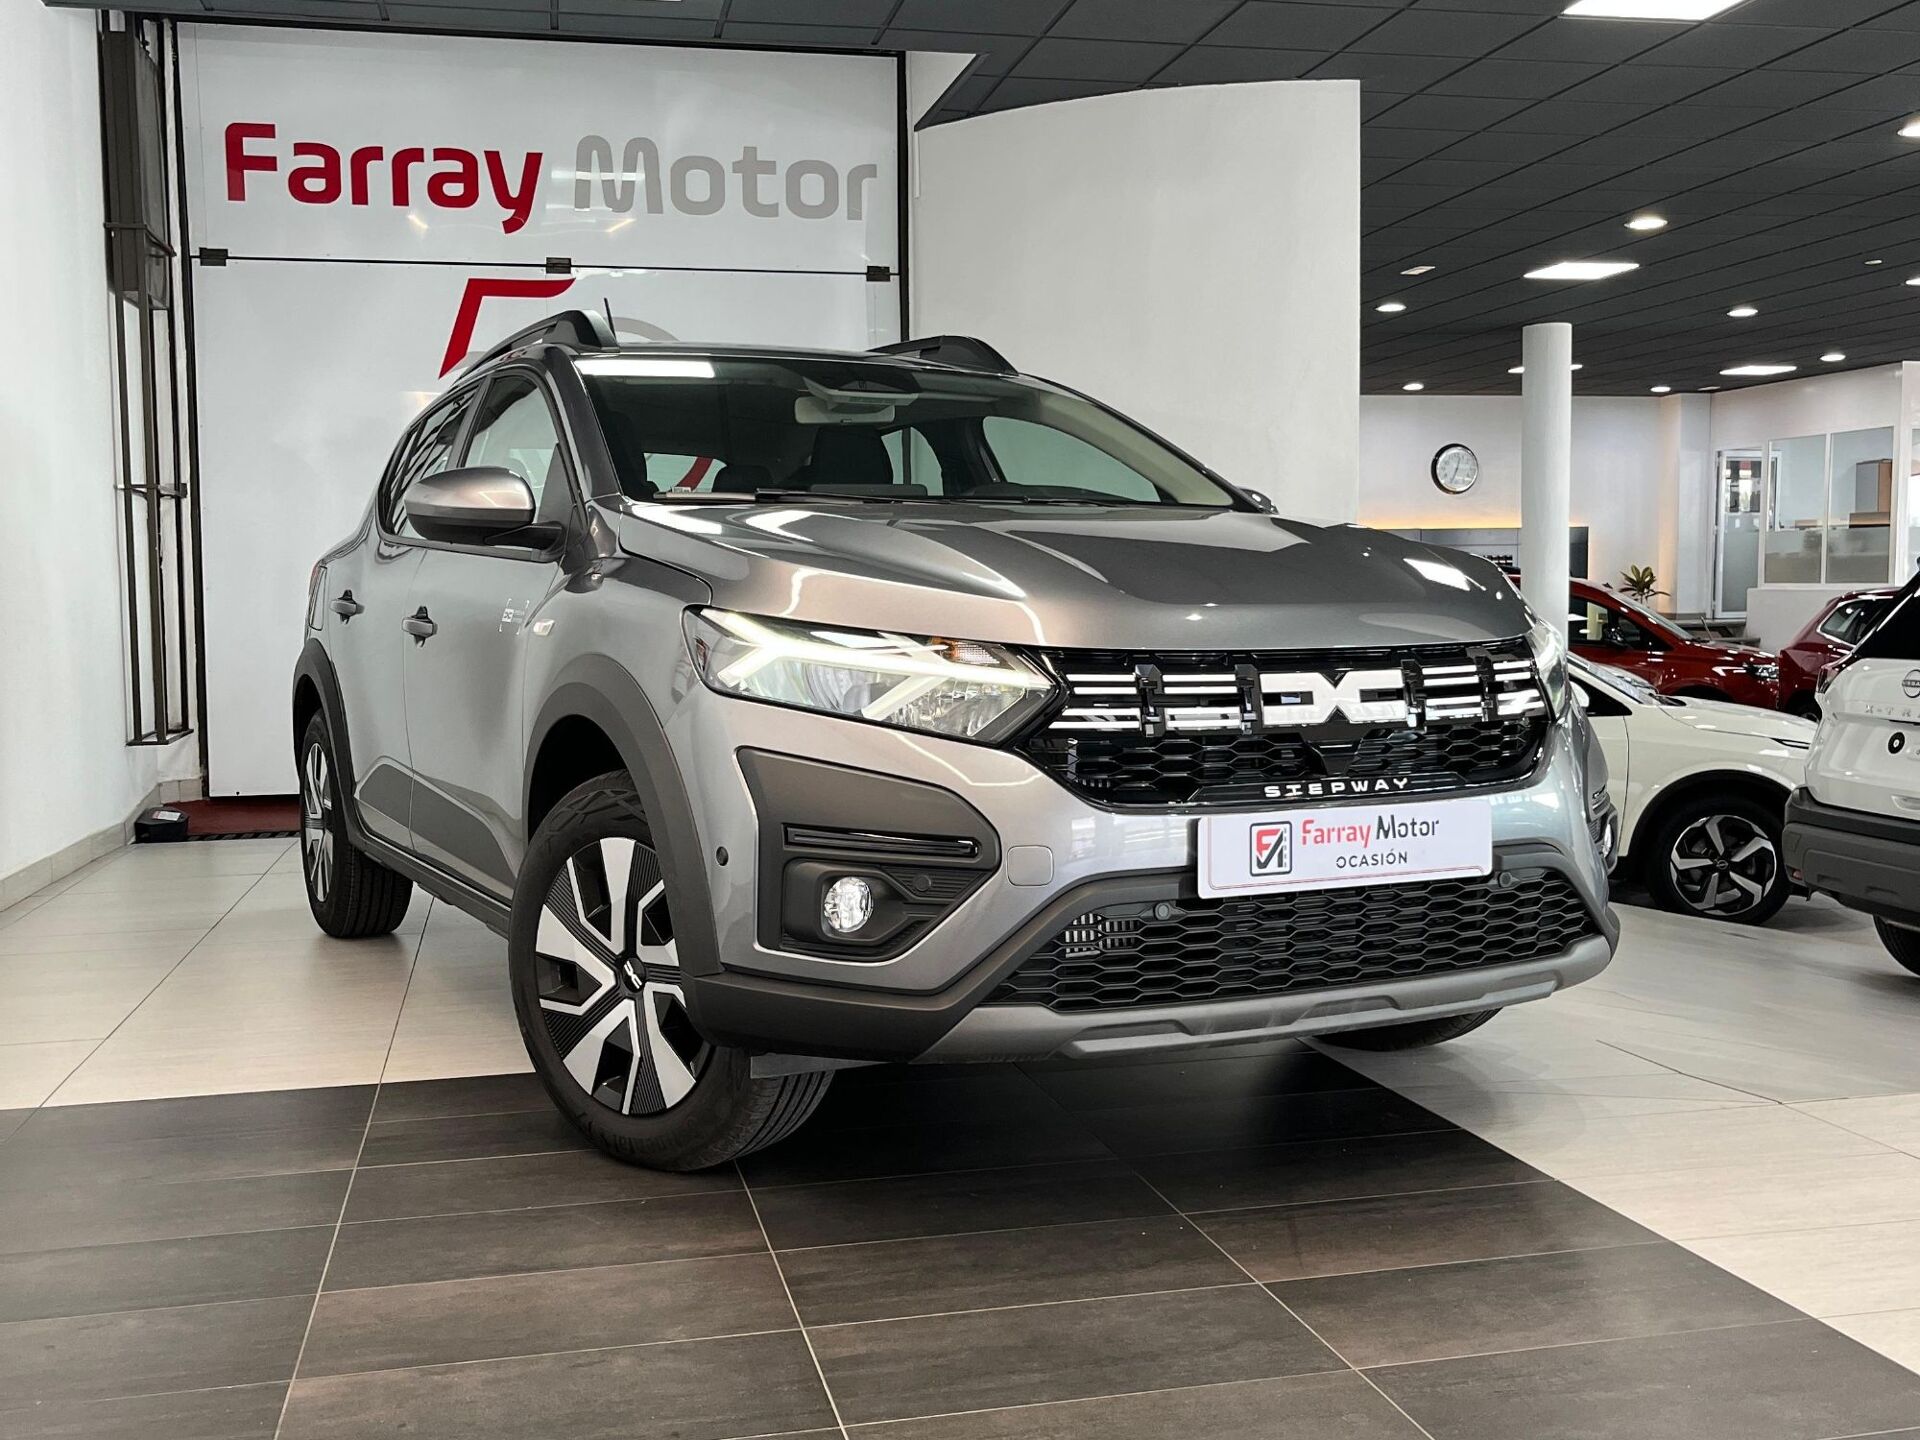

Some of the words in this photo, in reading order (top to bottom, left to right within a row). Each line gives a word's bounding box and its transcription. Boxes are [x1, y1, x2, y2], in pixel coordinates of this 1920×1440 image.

[225, 122, 542, 234] Farray
[574, 135, 877, 220] Motor
[1301, 819, 1371, 848] Farray
[1376, 814, 1440, 840] Motor
[1335, 848, 1408, 869] OCASIÓN
